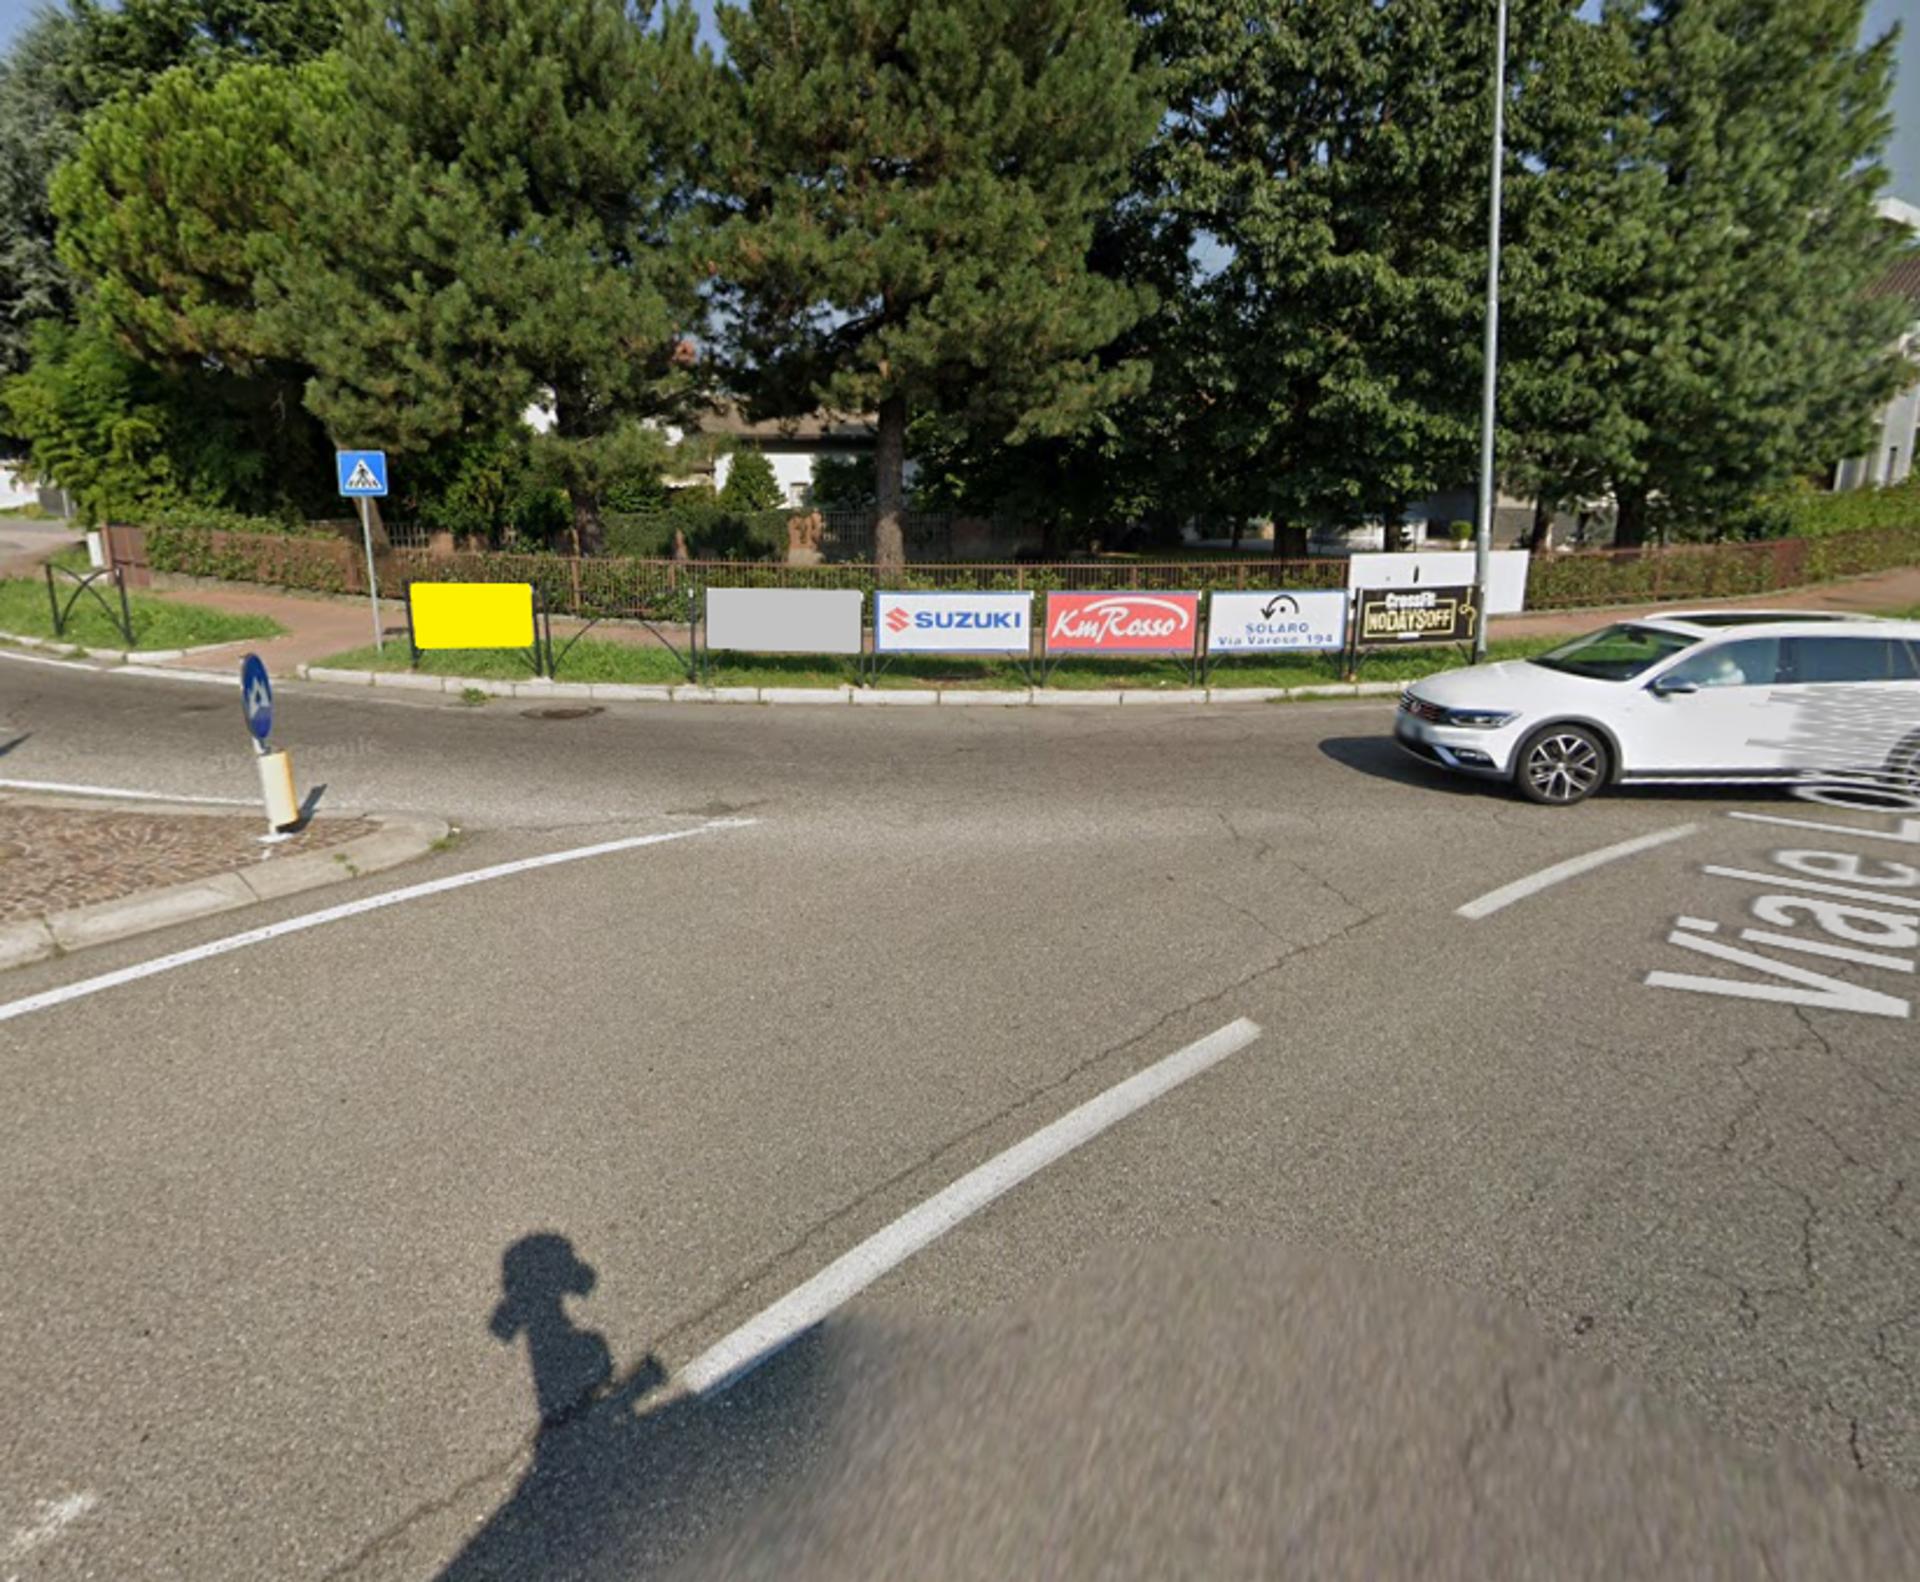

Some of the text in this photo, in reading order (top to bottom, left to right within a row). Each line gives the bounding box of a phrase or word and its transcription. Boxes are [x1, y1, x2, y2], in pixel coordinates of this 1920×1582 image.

[914, 611, 1021, 629] SUZUKI
[1245, 622, 1310, 634] SOLARO
[1218, 636, 1242, 645] Via
[1306, 634, 1333, 644] 194
